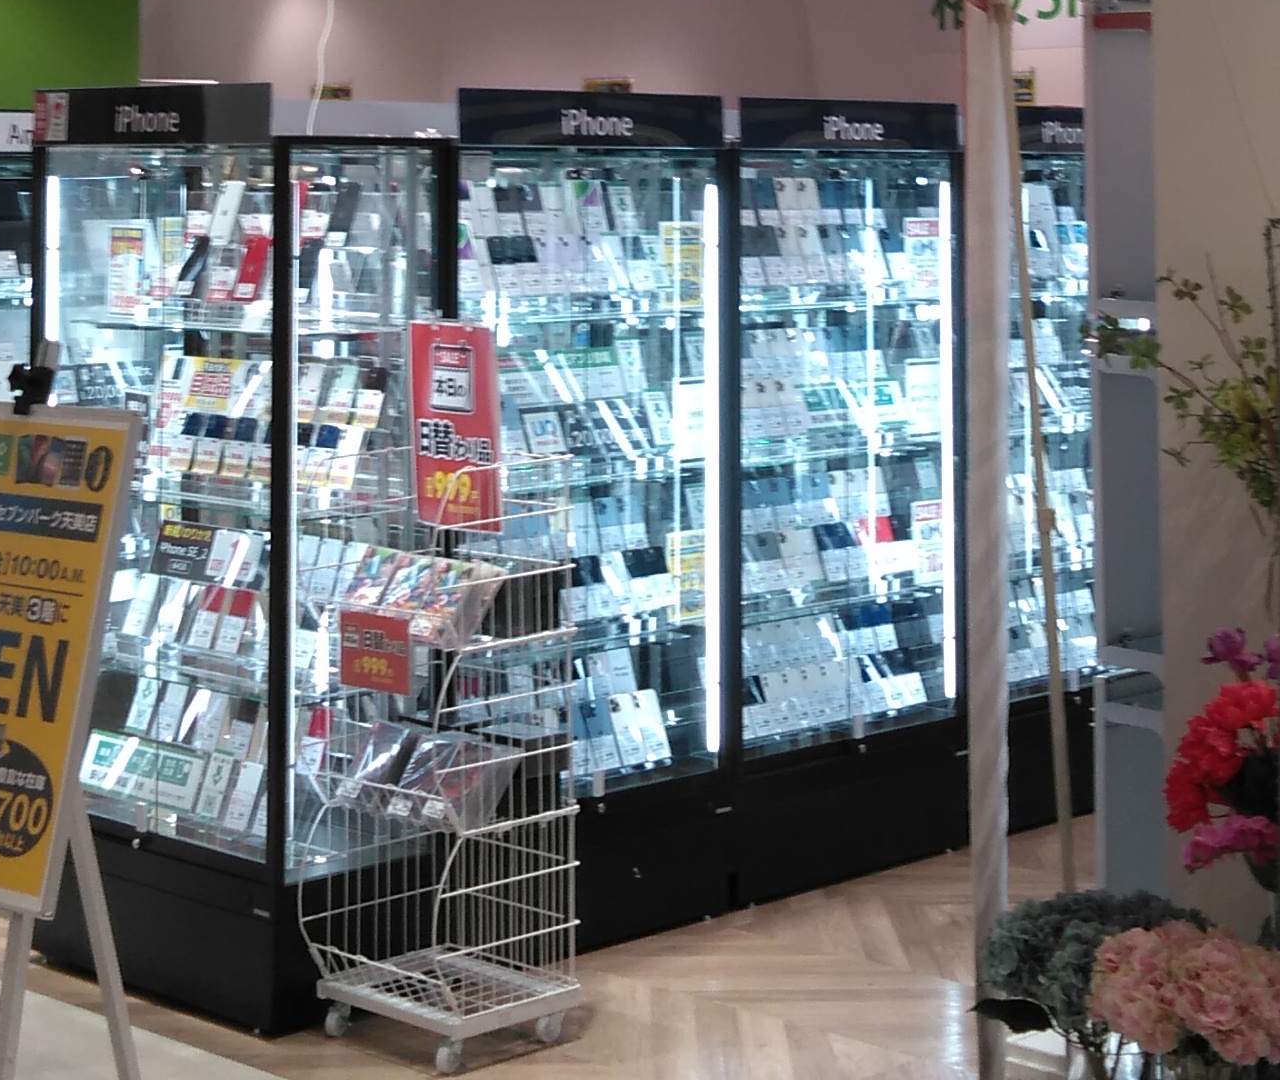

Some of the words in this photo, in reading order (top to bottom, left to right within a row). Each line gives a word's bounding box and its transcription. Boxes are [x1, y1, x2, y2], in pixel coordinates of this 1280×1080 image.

[114, 104, 180, 133] iPhone
[561, 108, 634, 136] iPhone
[822, 115, 885, 141] iPhone
